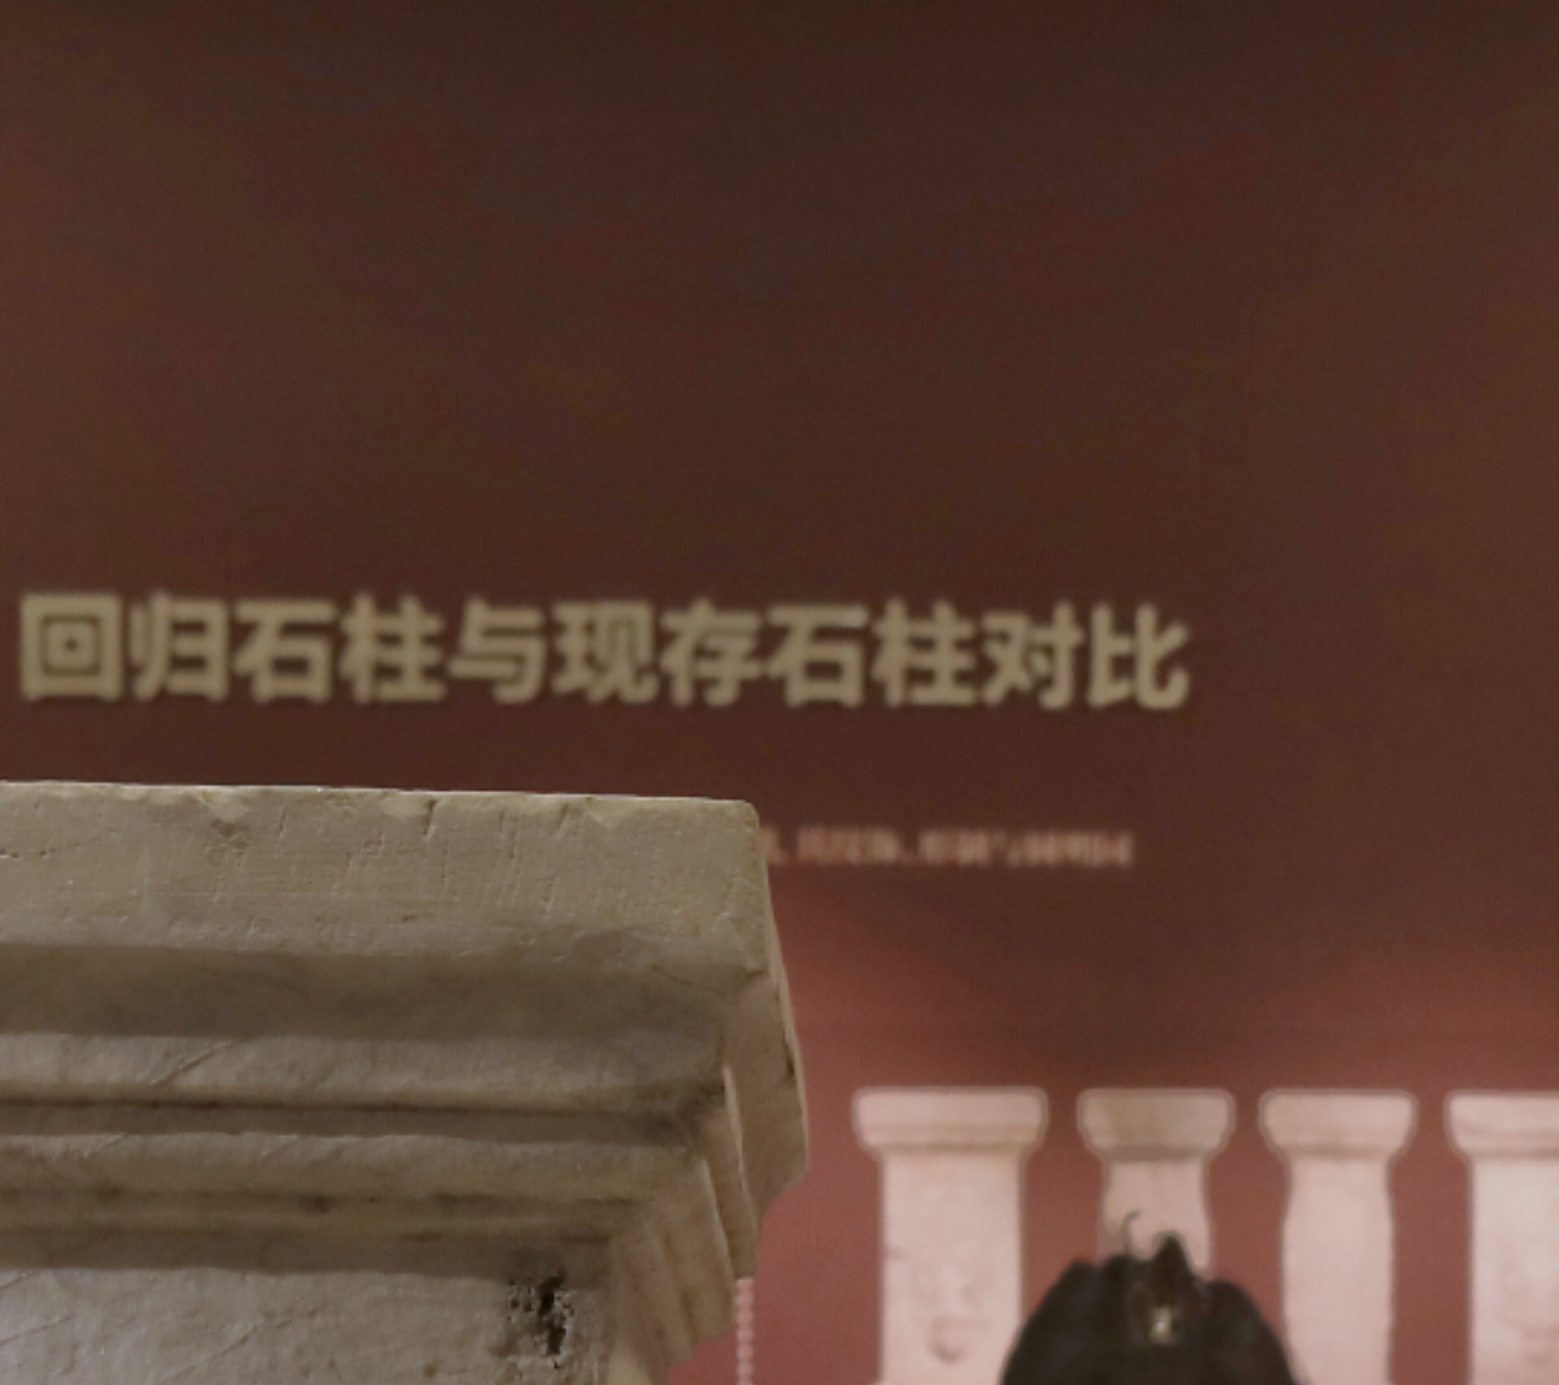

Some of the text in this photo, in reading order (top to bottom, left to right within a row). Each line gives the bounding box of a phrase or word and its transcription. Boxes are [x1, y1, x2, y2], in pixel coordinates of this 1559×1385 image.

[20, 592, 1190, 710] 回归石柱与现存石柱对比
